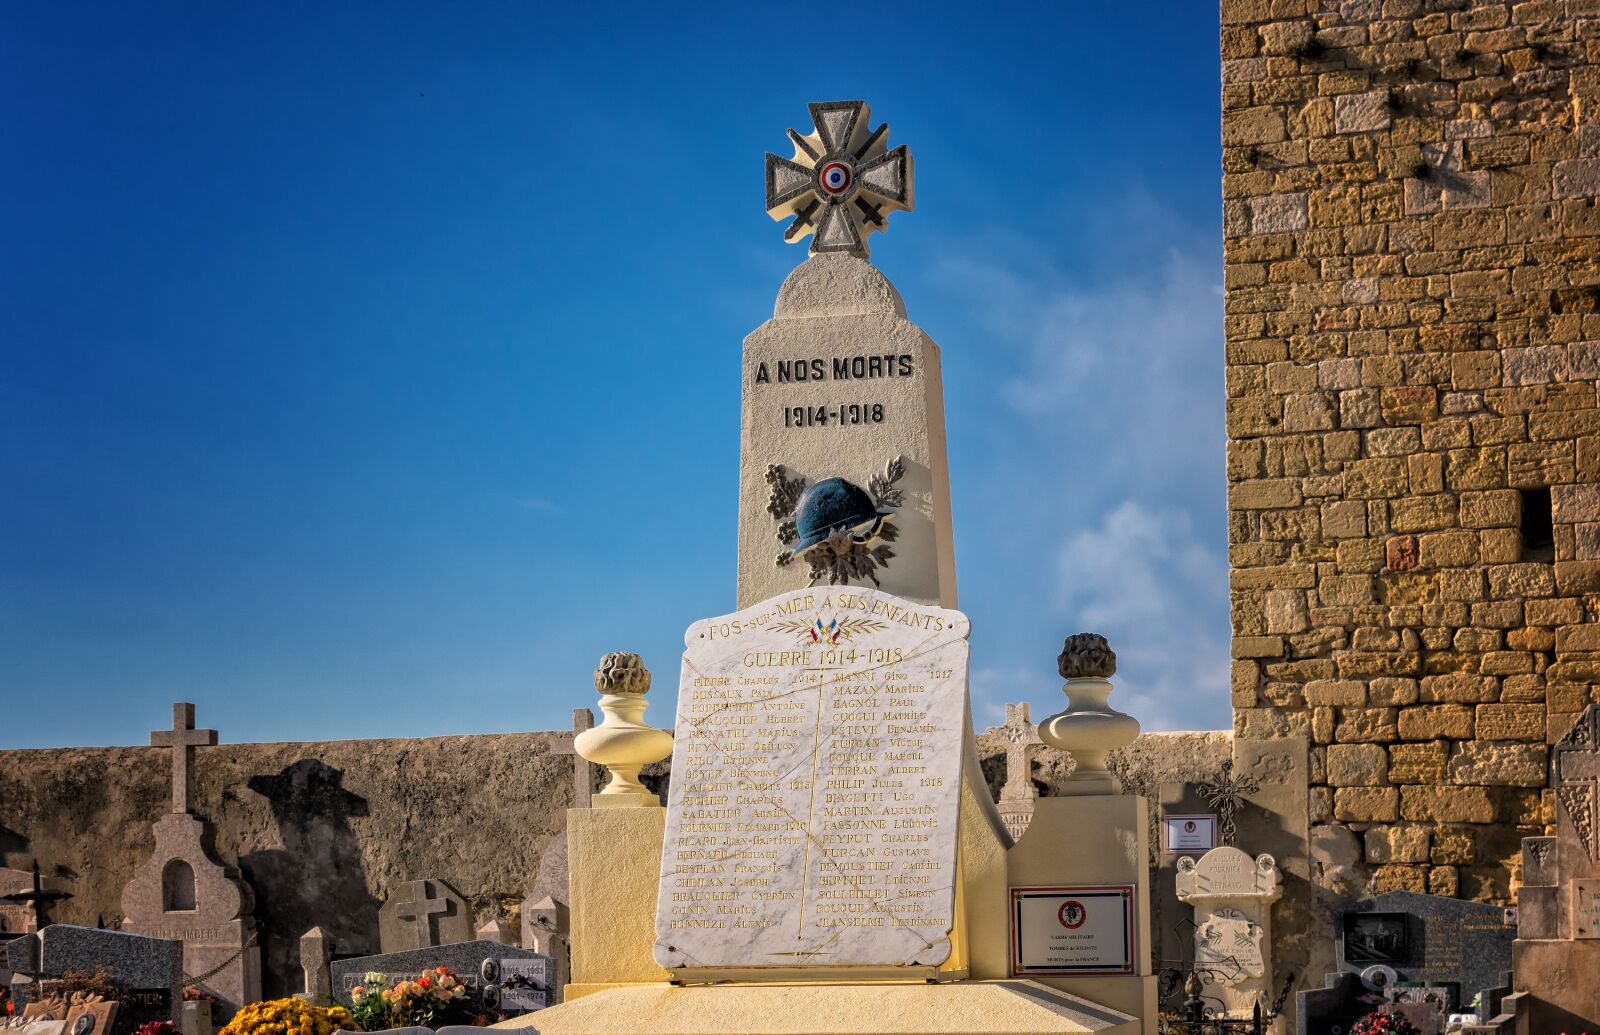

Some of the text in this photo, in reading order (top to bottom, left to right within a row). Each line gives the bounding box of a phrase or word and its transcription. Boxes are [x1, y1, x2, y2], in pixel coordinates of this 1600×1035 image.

[755, 354, 912, 383] A NOS MORTS
[784, 404, 884, 427] 1914-1918
[822, 596, 833, 608] A
[838, 594, 867, 611] SES
[871, 599, 945, 631] ENFANTS
[744, 647, 904, 668] GUERRE 1914-1918
[695, 677, 730, 687] PIERRE
[834, 685, 878, 695] MAZAN
[826, 780, 865, 790] PHILIP
[824, 806, 874, 817] MARTIN
